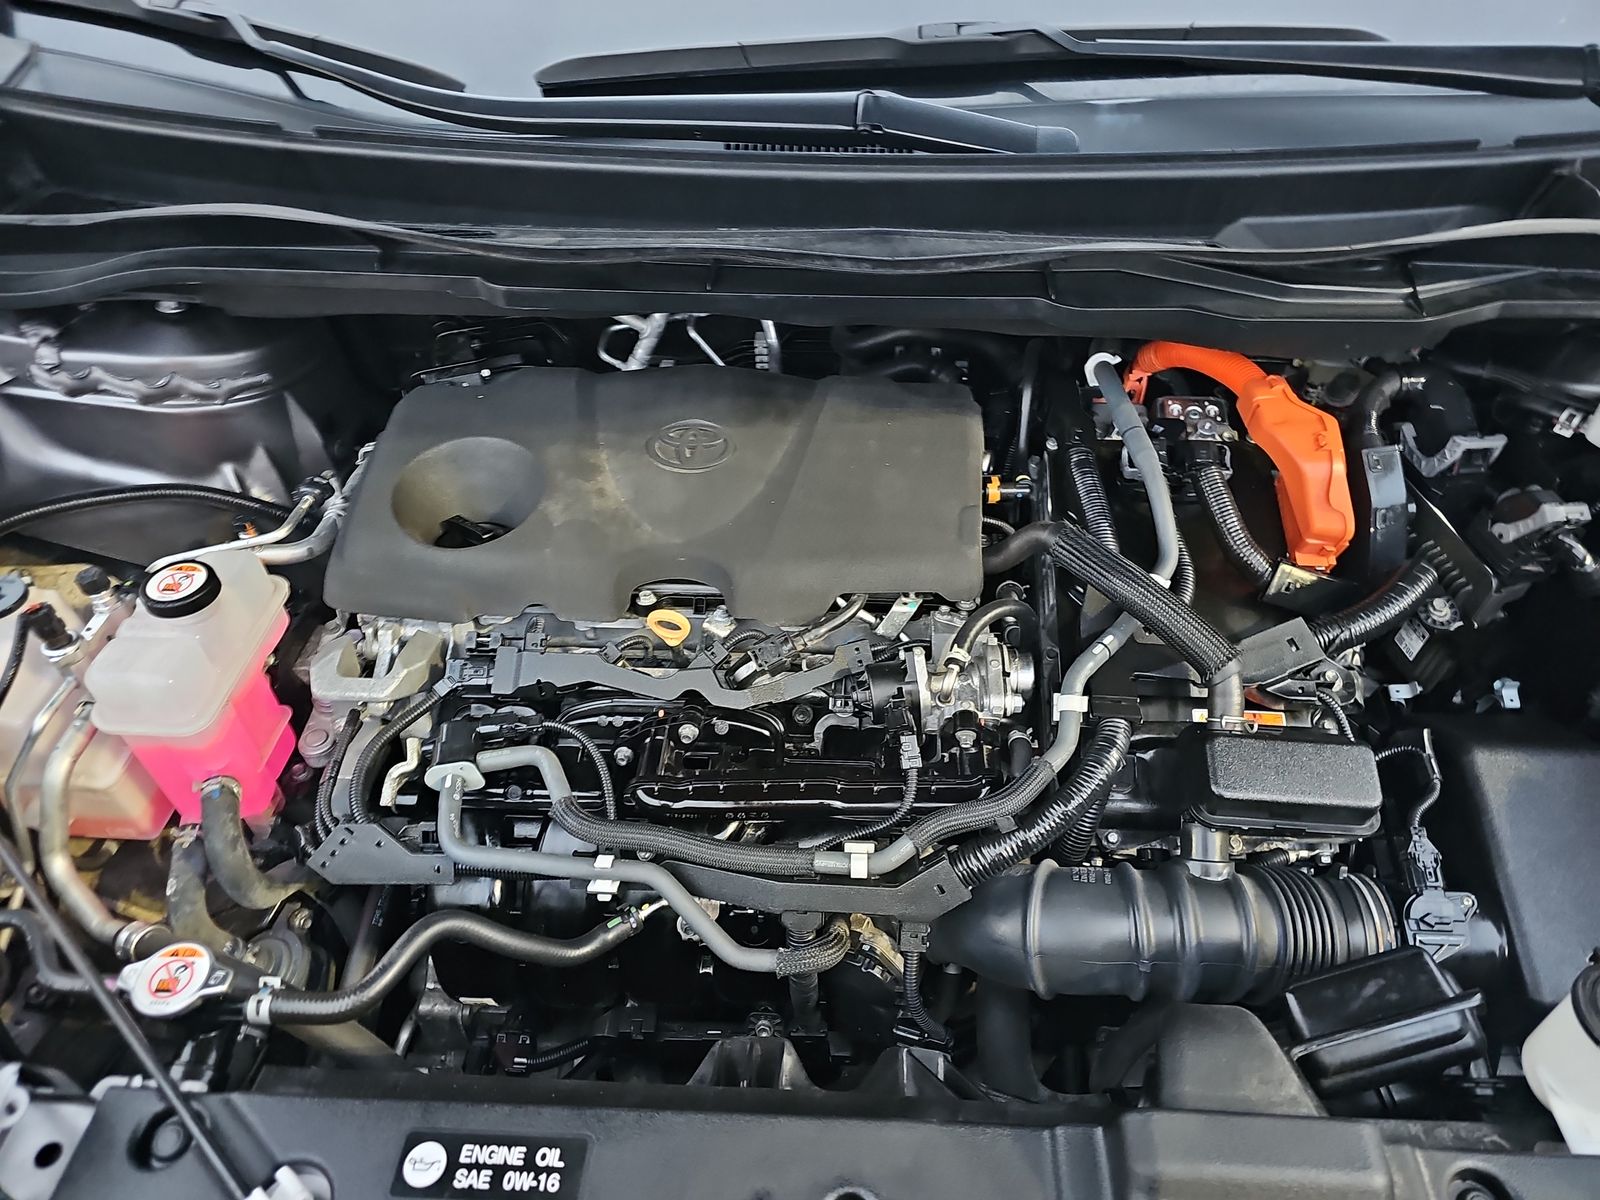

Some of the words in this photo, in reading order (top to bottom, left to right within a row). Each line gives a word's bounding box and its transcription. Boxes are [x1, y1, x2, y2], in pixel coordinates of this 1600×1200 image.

[458, 1143, 527, 1166] ENGINE
[535, 1146, 565, 1168] OIL
[452, 1167, 493, 1190] SAE
[502, 1170, 561, 1194] 0W-16
